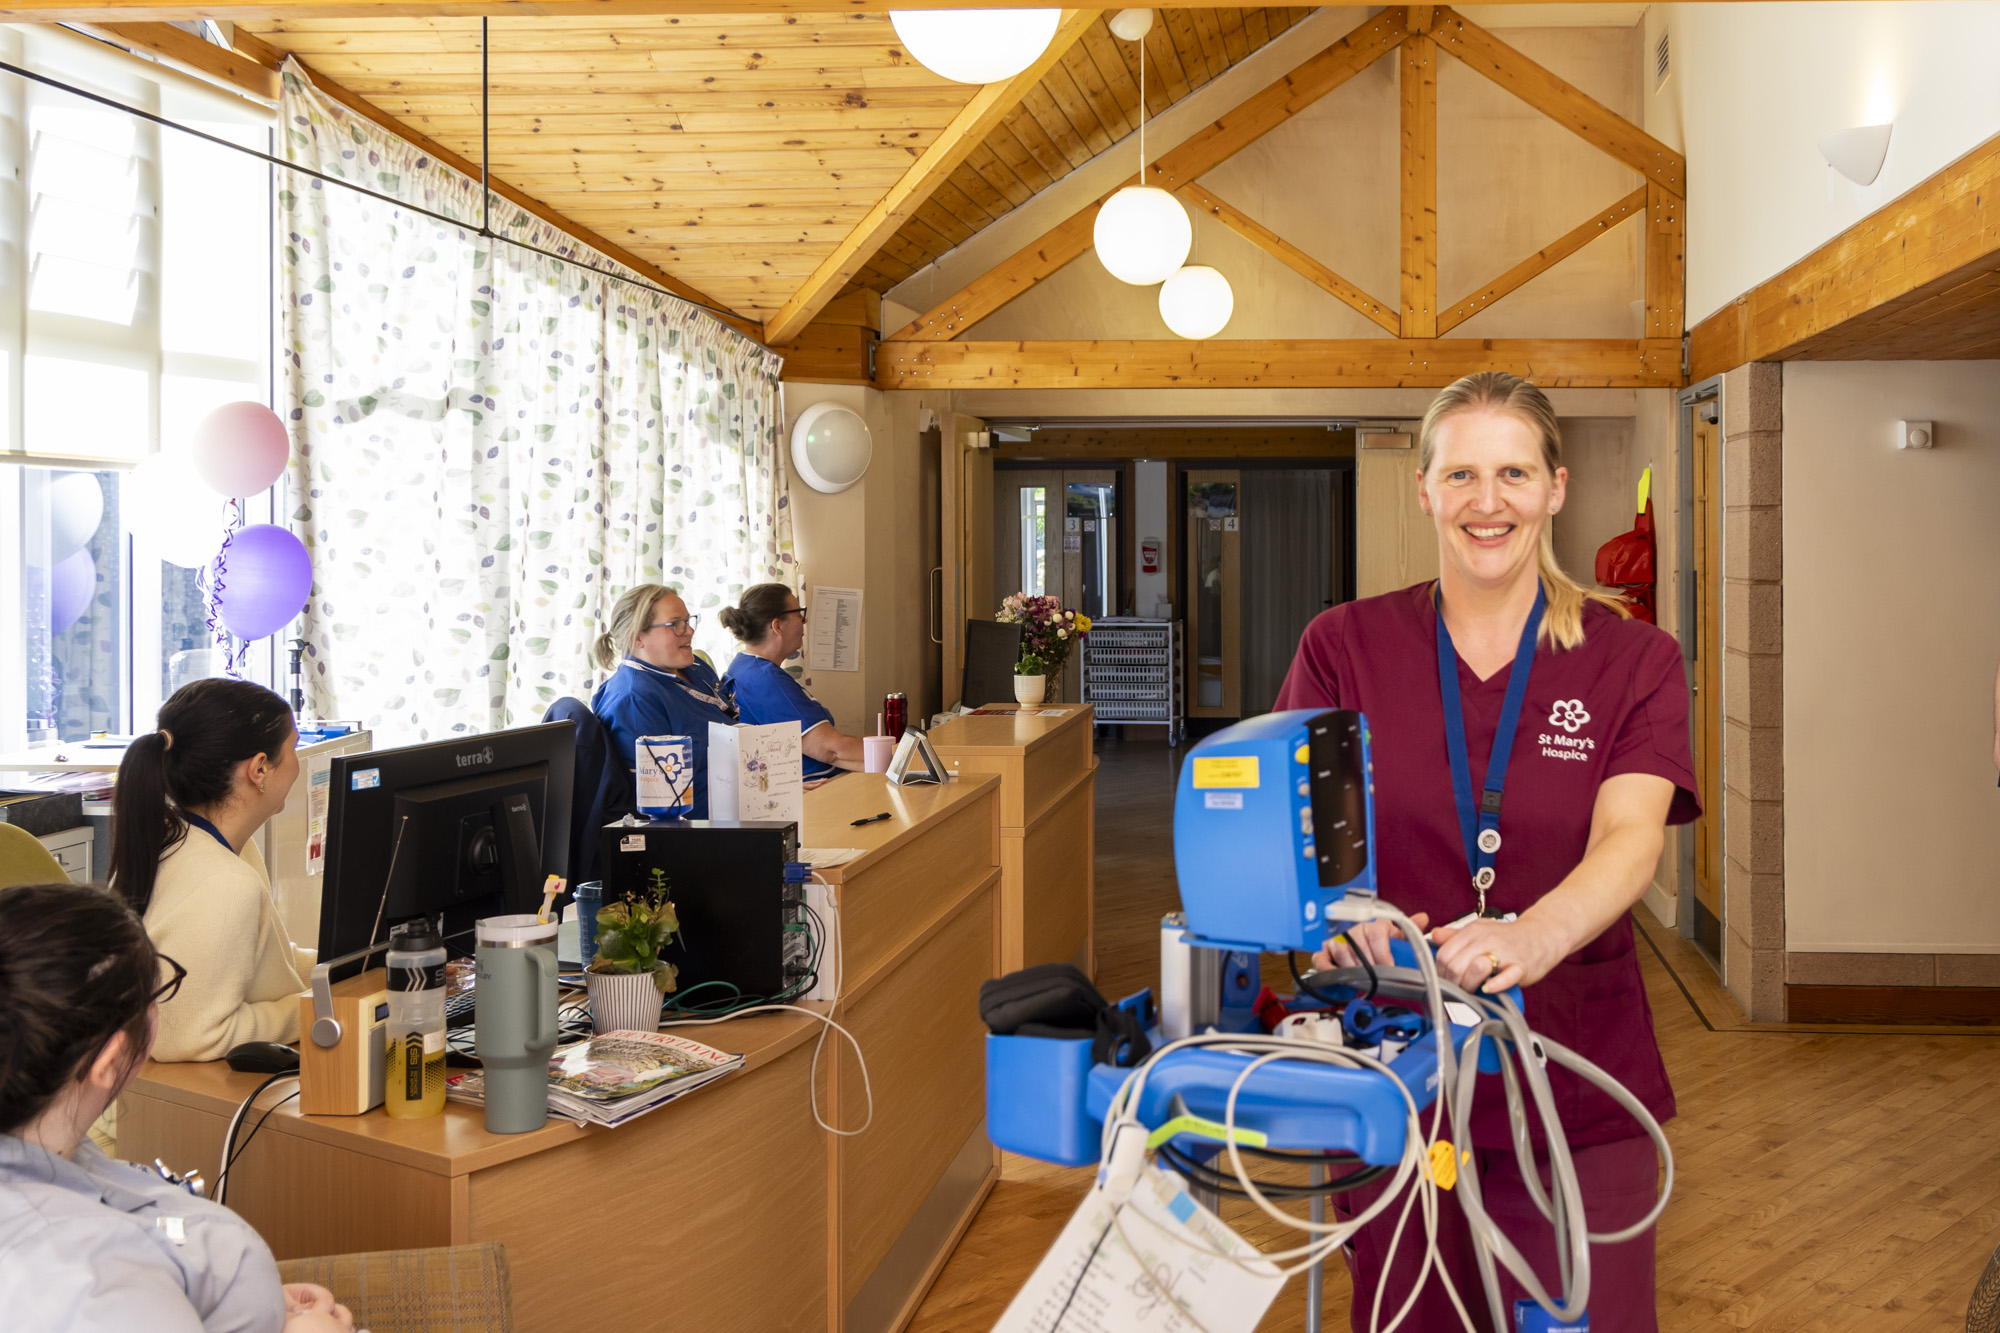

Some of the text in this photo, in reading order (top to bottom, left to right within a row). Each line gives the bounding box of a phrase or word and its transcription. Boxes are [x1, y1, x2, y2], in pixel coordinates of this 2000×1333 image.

[1068, 518, 1076, 530] 3
[1227, 518, 1235, 529] 4
[1538, 733, 1595, 750] St Mary's
[456, 752, 483, 767] terra
[1542, 747, 1588, 762] Hospice
[676, 1041, 731, 1063] LIVING
